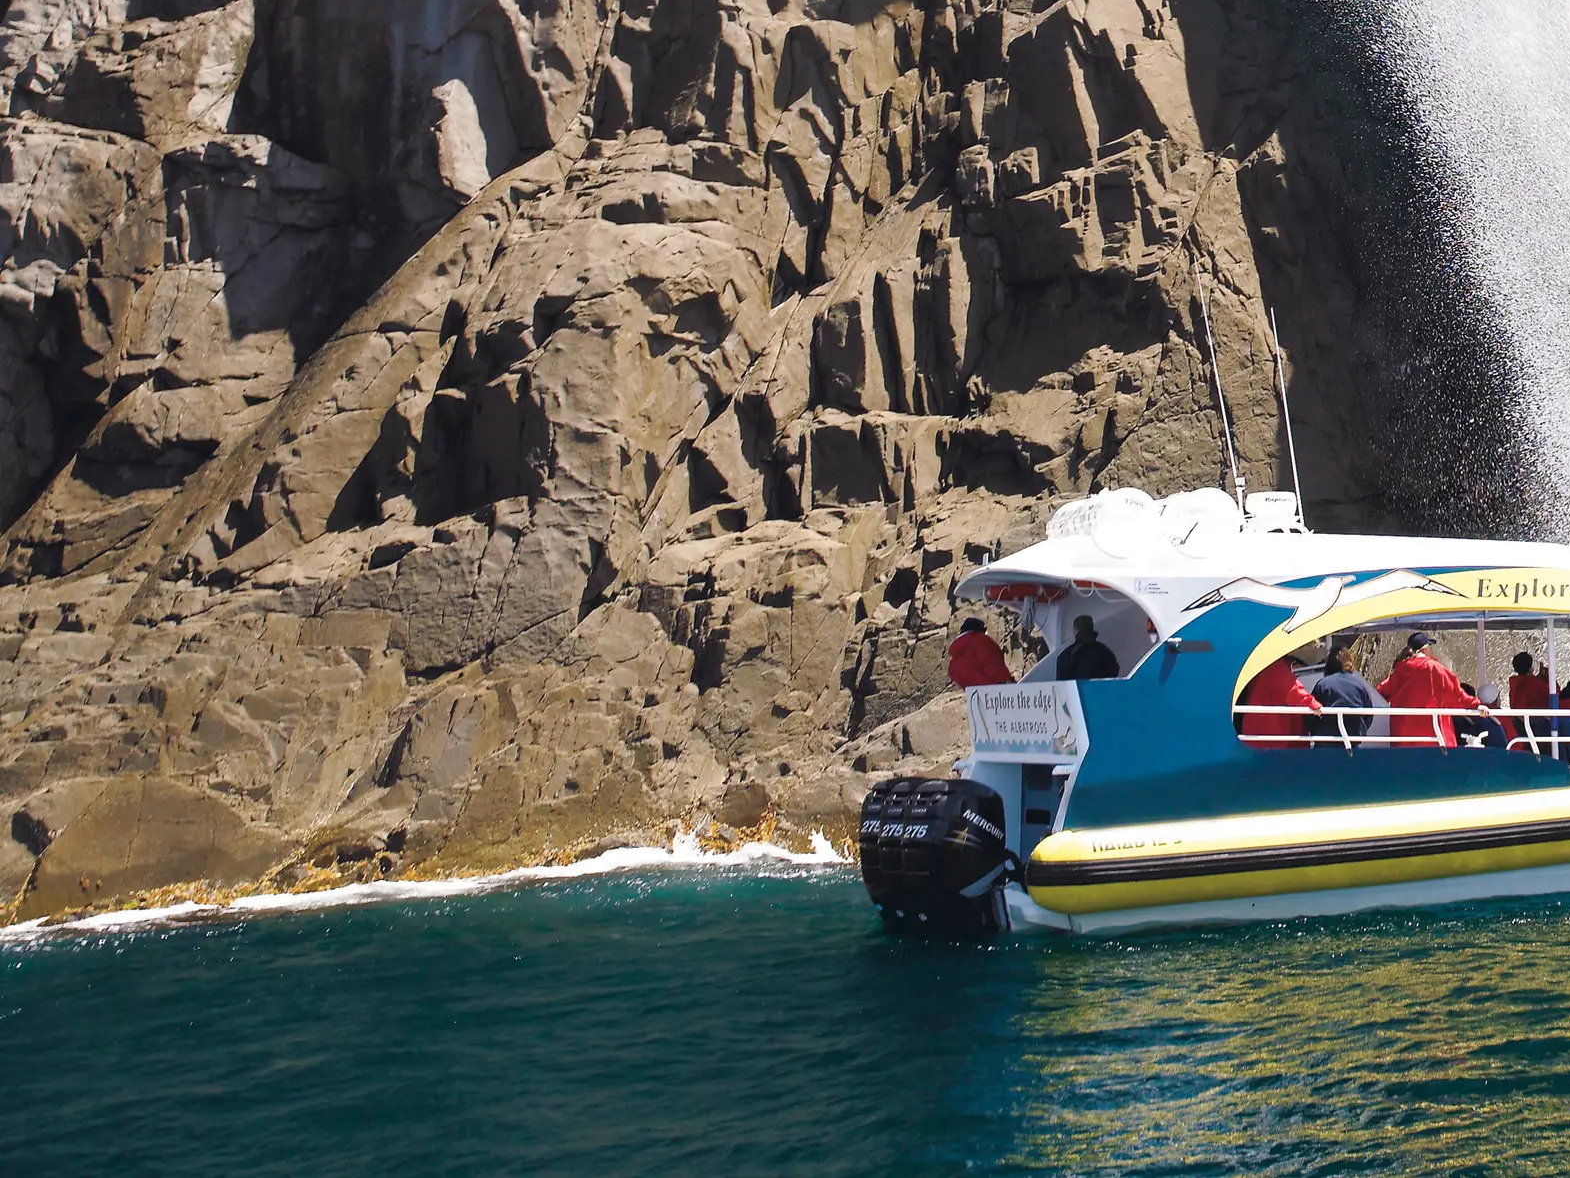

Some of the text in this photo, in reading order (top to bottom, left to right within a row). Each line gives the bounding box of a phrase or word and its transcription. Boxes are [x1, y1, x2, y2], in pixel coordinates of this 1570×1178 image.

[984, 690, 1053, 715] Explore the edge
[995, 721, 1048, 735] THE ALBATROSS
[881, 824, 904, 838] 275
[903, 824, 928, 839] 275
[962, 808, 1005, 840] MERCURY
